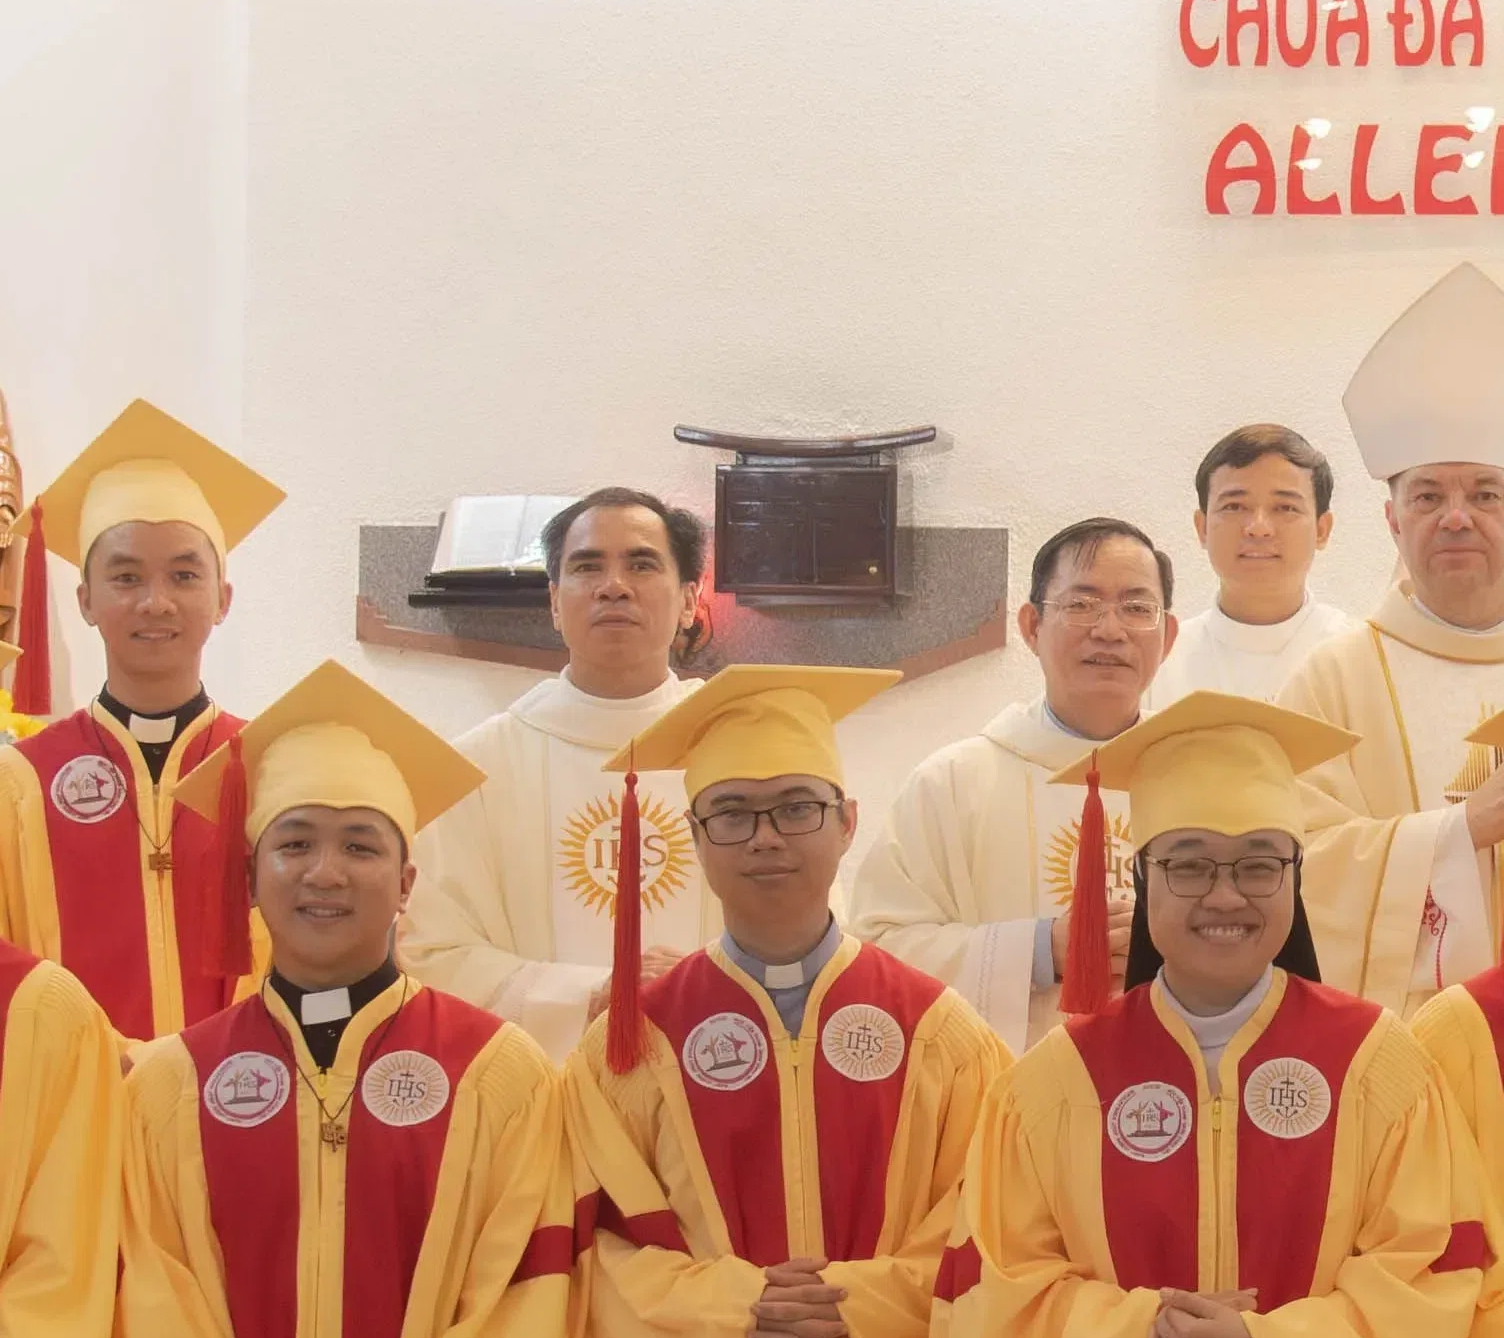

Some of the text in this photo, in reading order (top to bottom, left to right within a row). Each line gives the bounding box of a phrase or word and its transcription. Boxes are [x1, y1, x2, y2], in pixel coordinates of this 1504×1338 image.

[846, 1031, 884, 1054] IHS
[388, 1079, 427, 1099] IHS
[1269, 1086, 1308, 1109] IHS
